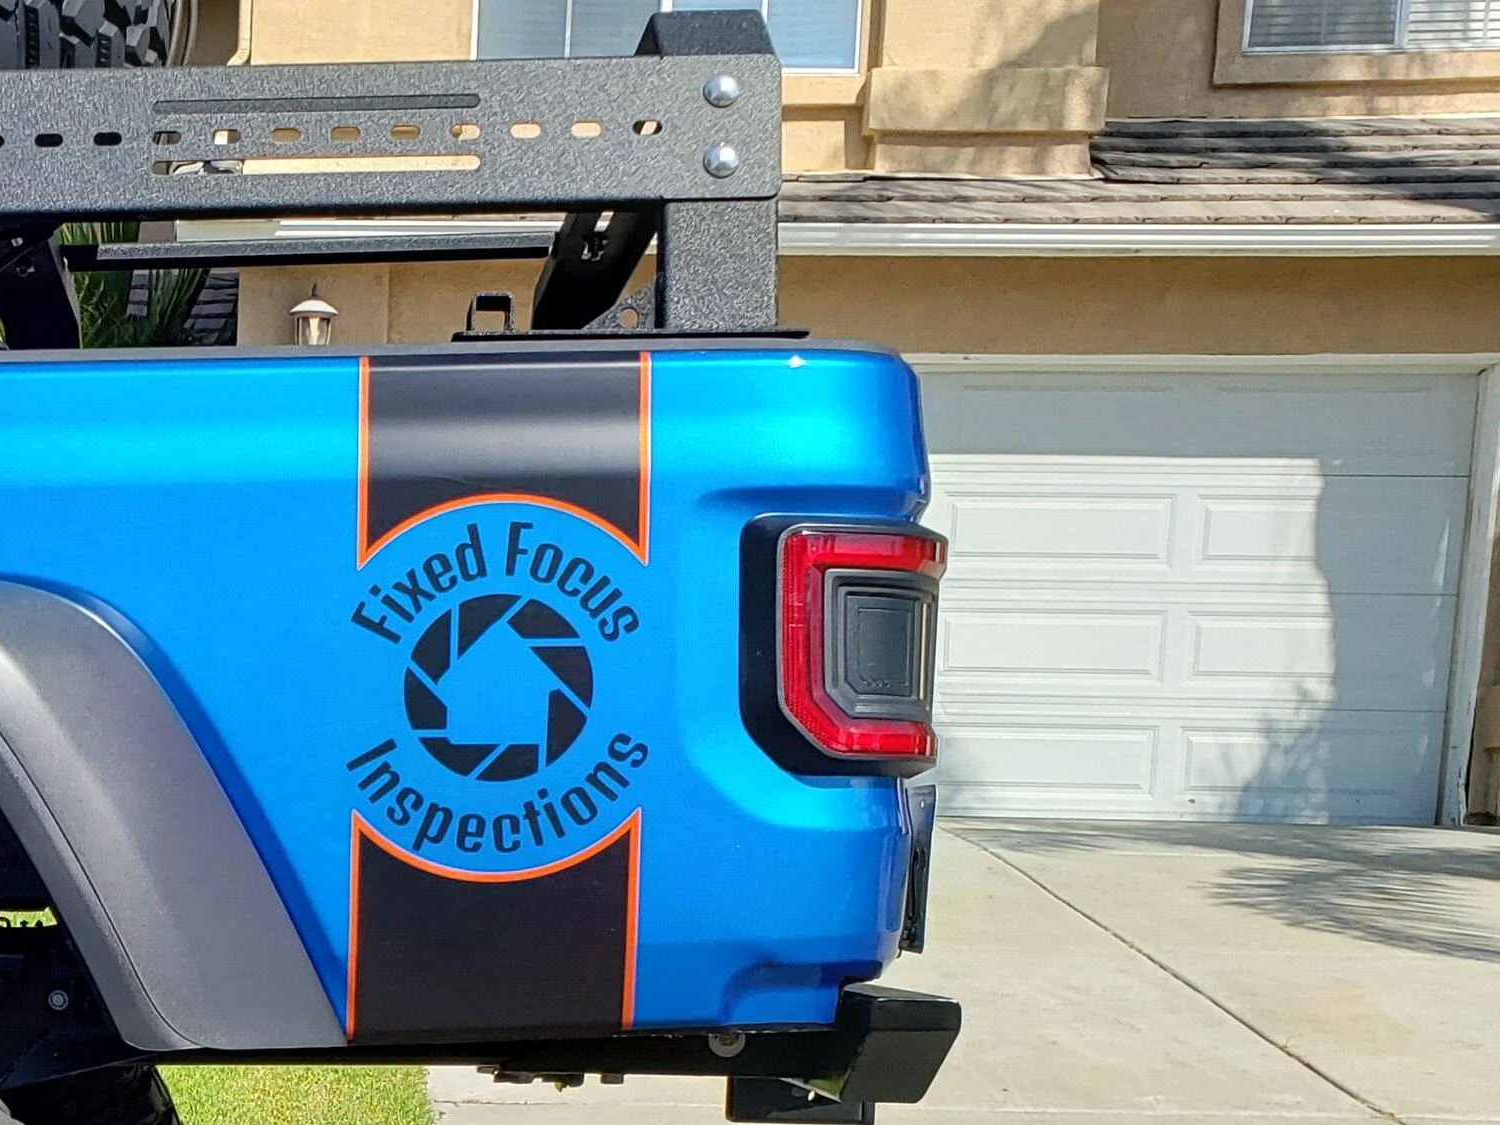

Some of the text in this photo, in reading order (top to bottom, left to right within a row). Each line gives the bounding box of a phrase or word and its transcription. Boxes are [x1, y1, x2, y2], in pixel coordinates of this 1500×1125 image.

[350, 521, 640, 645] Fixed Focus
[346, 733, 649, 854] Inspections
